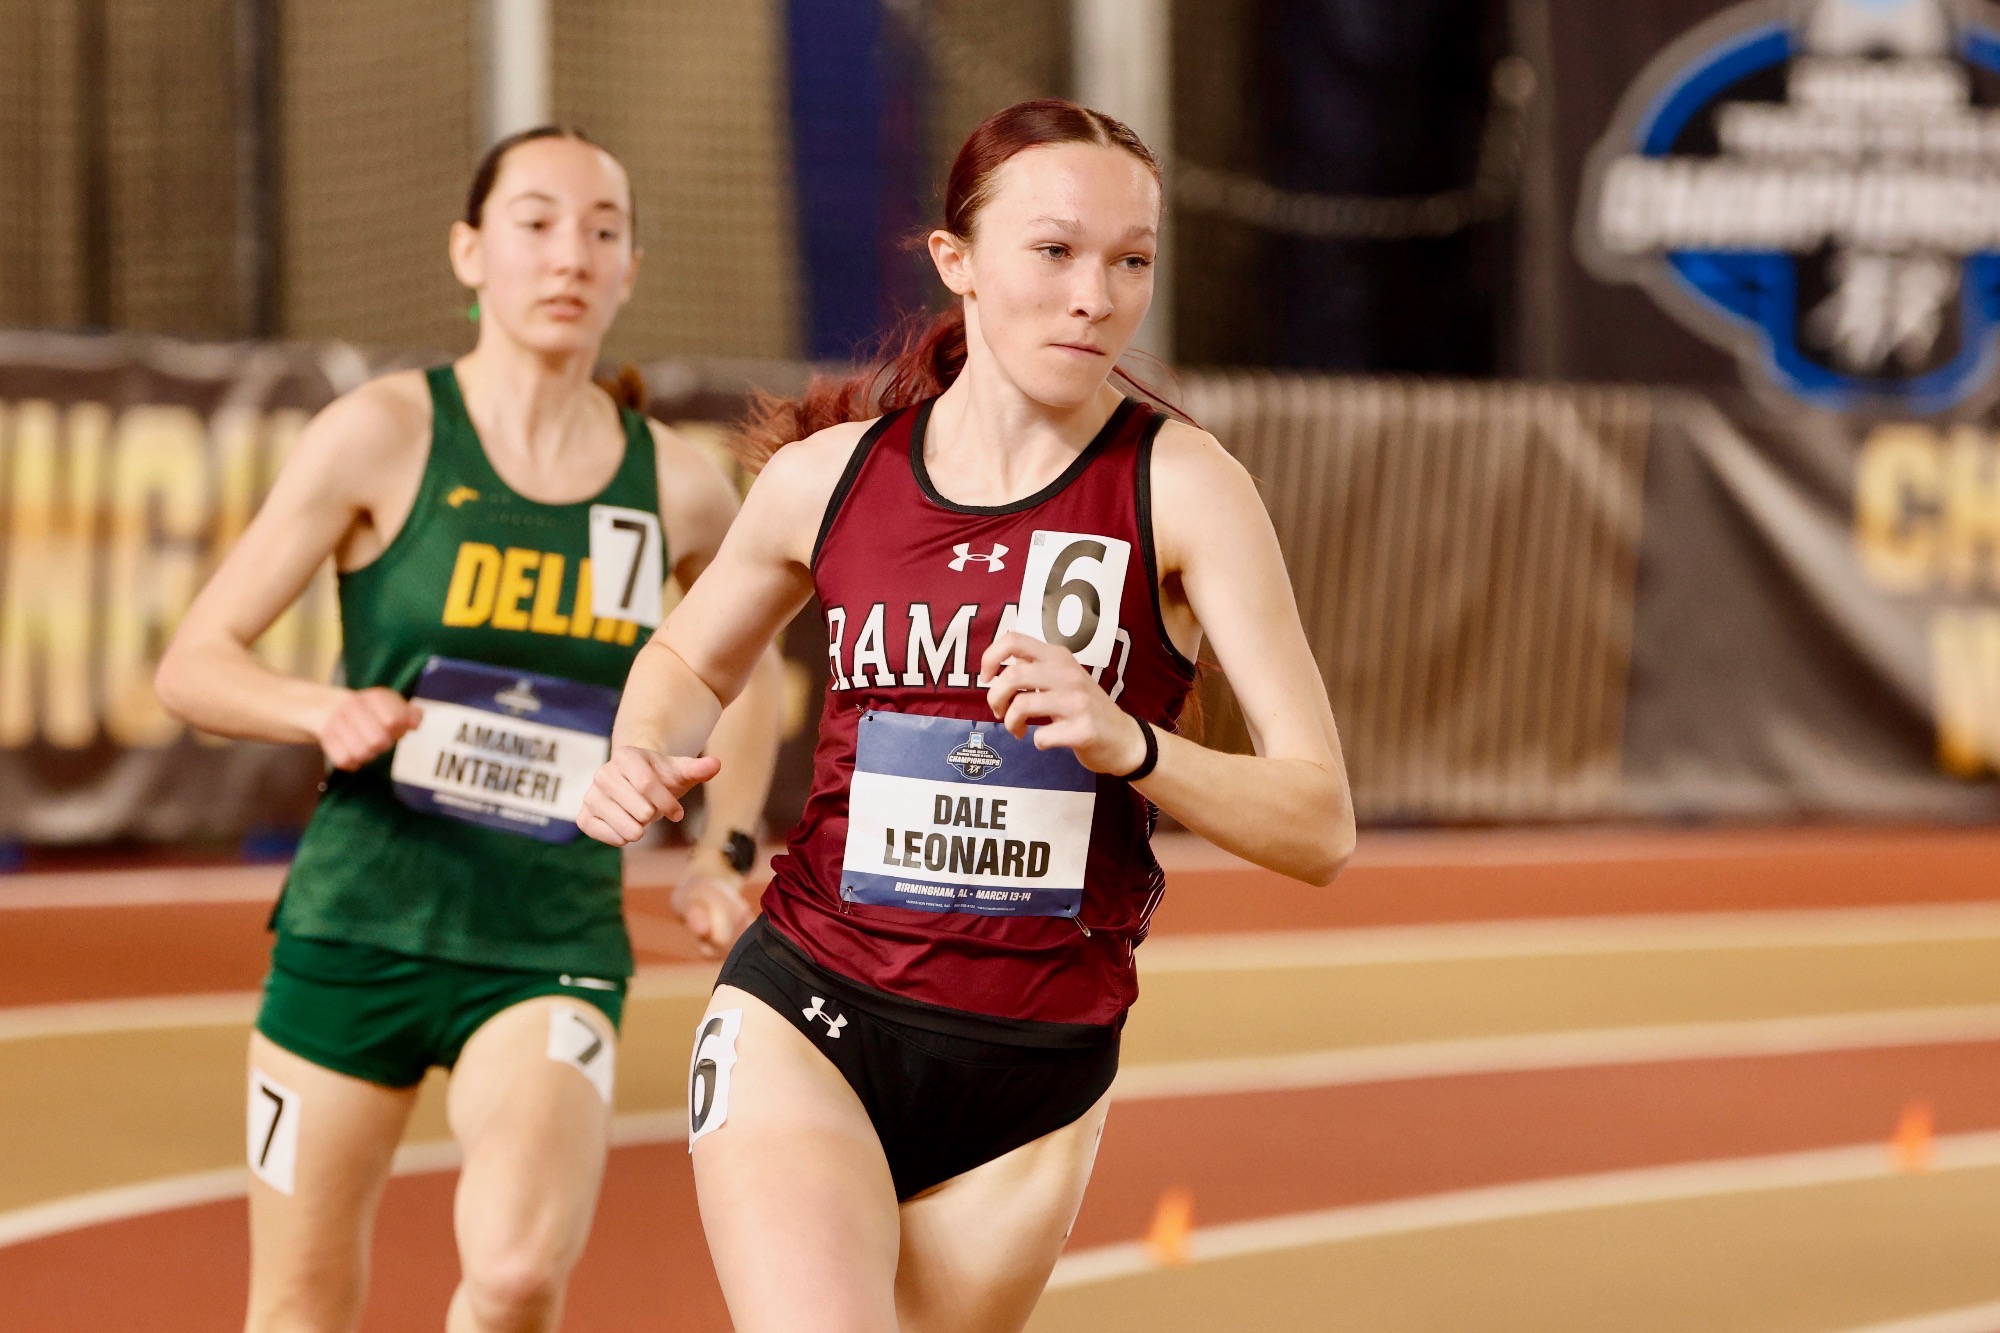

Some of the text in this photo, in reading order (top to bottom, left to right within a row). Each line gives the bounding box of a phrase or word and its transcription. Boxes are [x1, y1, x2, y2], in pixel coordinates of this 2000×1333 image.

[612, 519, 647, 609] 7
[442, 541, 639, 647] DEL
[1042, 540, 1107, 653] 6
[455, 722, 559, 763] AMANDA
[949, 755, 1001, 766] CHAMPIONSHIPS
[435, 751, 562, 803] INTRIERI
[934, 794, 1008, 830] DALE
[883, 827, 1051, 878] LEONARD
[894, 882, 1032, 902] BIRMINGHAM, AL MARCH 13-14
[572, 1014, 604, 1065] 7
[691, 1017, 724, 1133] 6
[260, 1084, 284, 1167] 7
